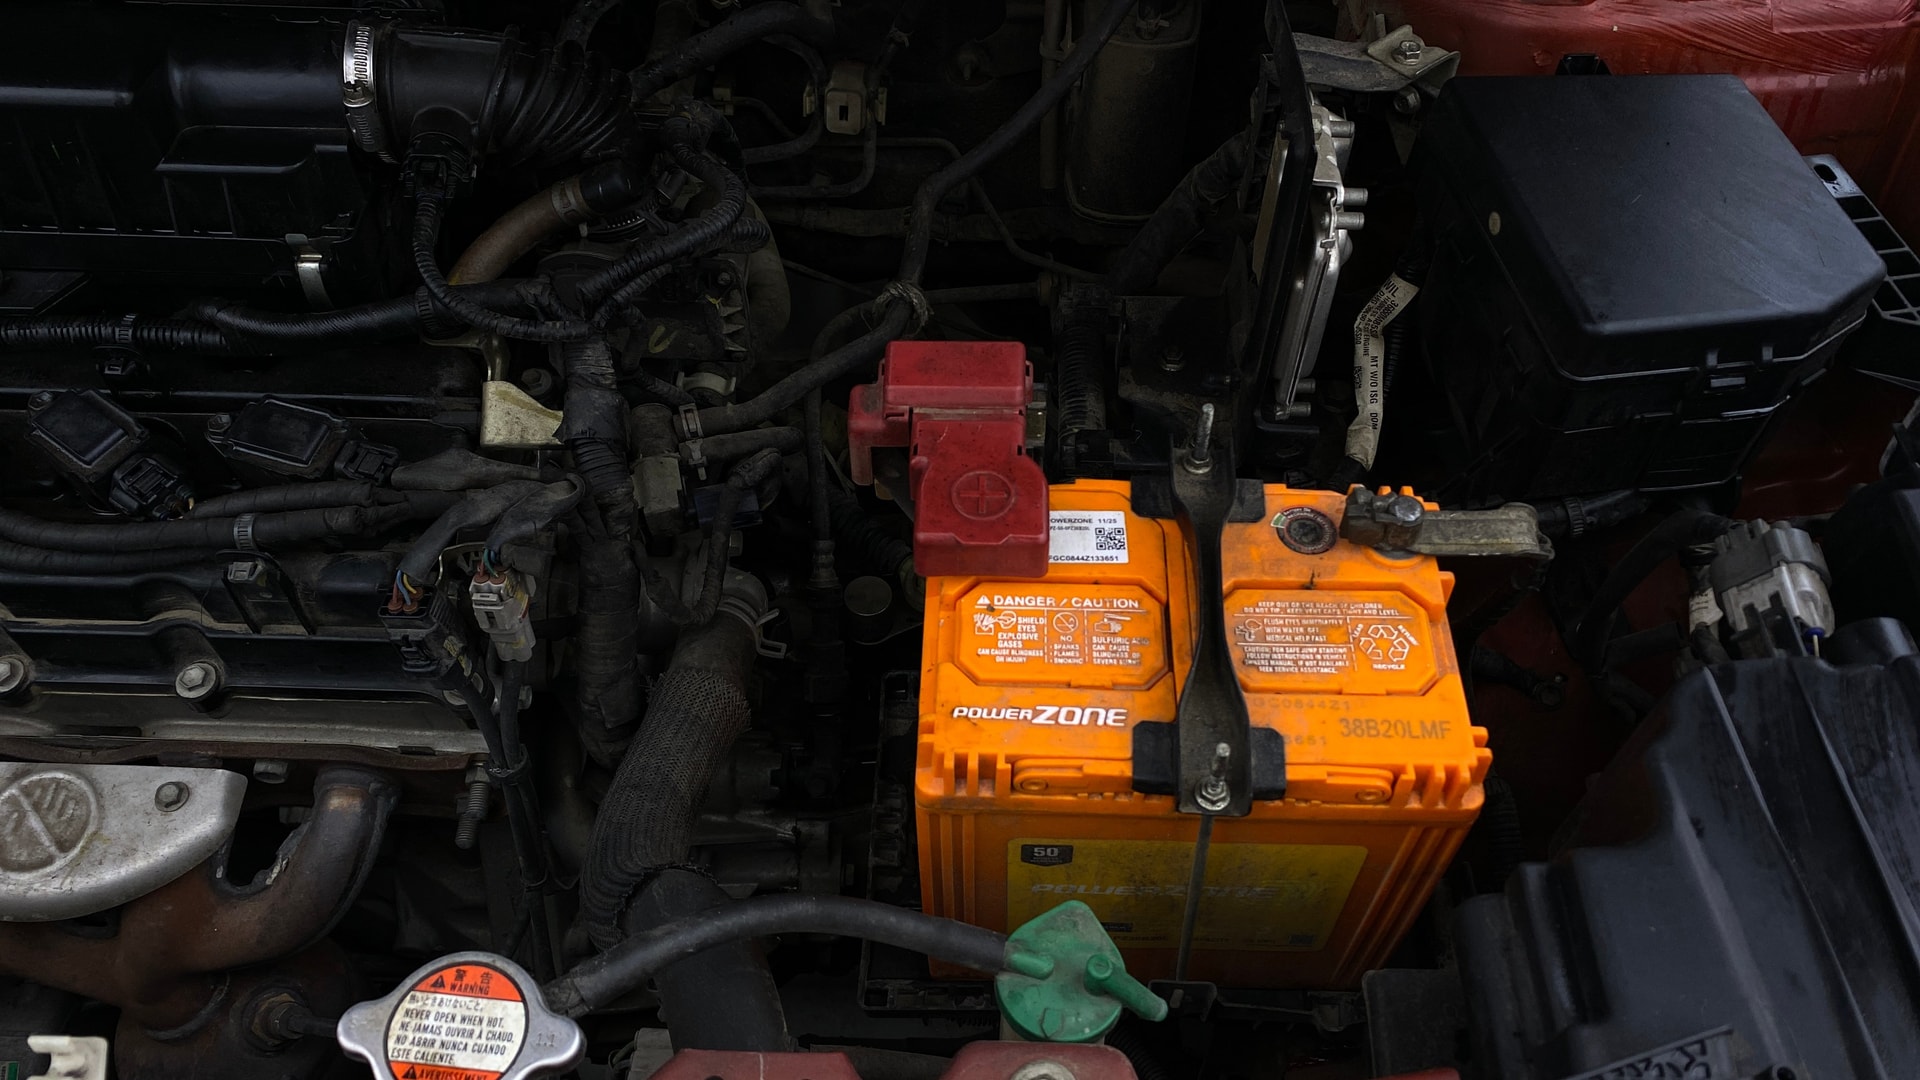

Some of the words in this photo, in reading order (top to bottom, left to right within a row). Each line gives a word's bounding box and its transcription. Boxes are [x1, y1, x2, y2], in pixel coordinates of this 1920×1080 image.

[1370, 355, 1378, 368] MT
[1370, 370, 1378, 387] W/O
[1370, 390, 1378, 404] ISG
[994, 595, 1056, 606] DANGER
[1071, 597, 1138, 608] CAUTION
[1017, 616, 1045, 624] SHIELD
[1018, 624, 1036, 632] EYES
[998, 632, 1038, 640] EXPLOSIVE
[1092, 636, 1130, 644] SULFURIC
[998, 640, 1022, 648] GASES
[952, 705, 1128, 726] POWERZONE
[1339, 717, 1452, 740] 38B20LMF
[1033, 847, 1059, 857] 50
[450, 983, 489, 995] WARNING
[403, 1008, 430, 1020] NEVER
[434, 1011, 457, 1023] OPEN
[460, 1014, 484, 1026] WHEN
[486, 1017, 504, 1028] HOT.
[398, 1021, 409, 1031] NE
[412, 1023, 442, 1036] JAMAIS
[445, 1026, 475, 1039] OUVRIR
[394, 1034, 406, 1045] NO
[409, 1037, 435, 1049] ABRIR
[439, 1040, 468, 1052] NUNCA
[471, 1043, 506, 1056] CUANDO
